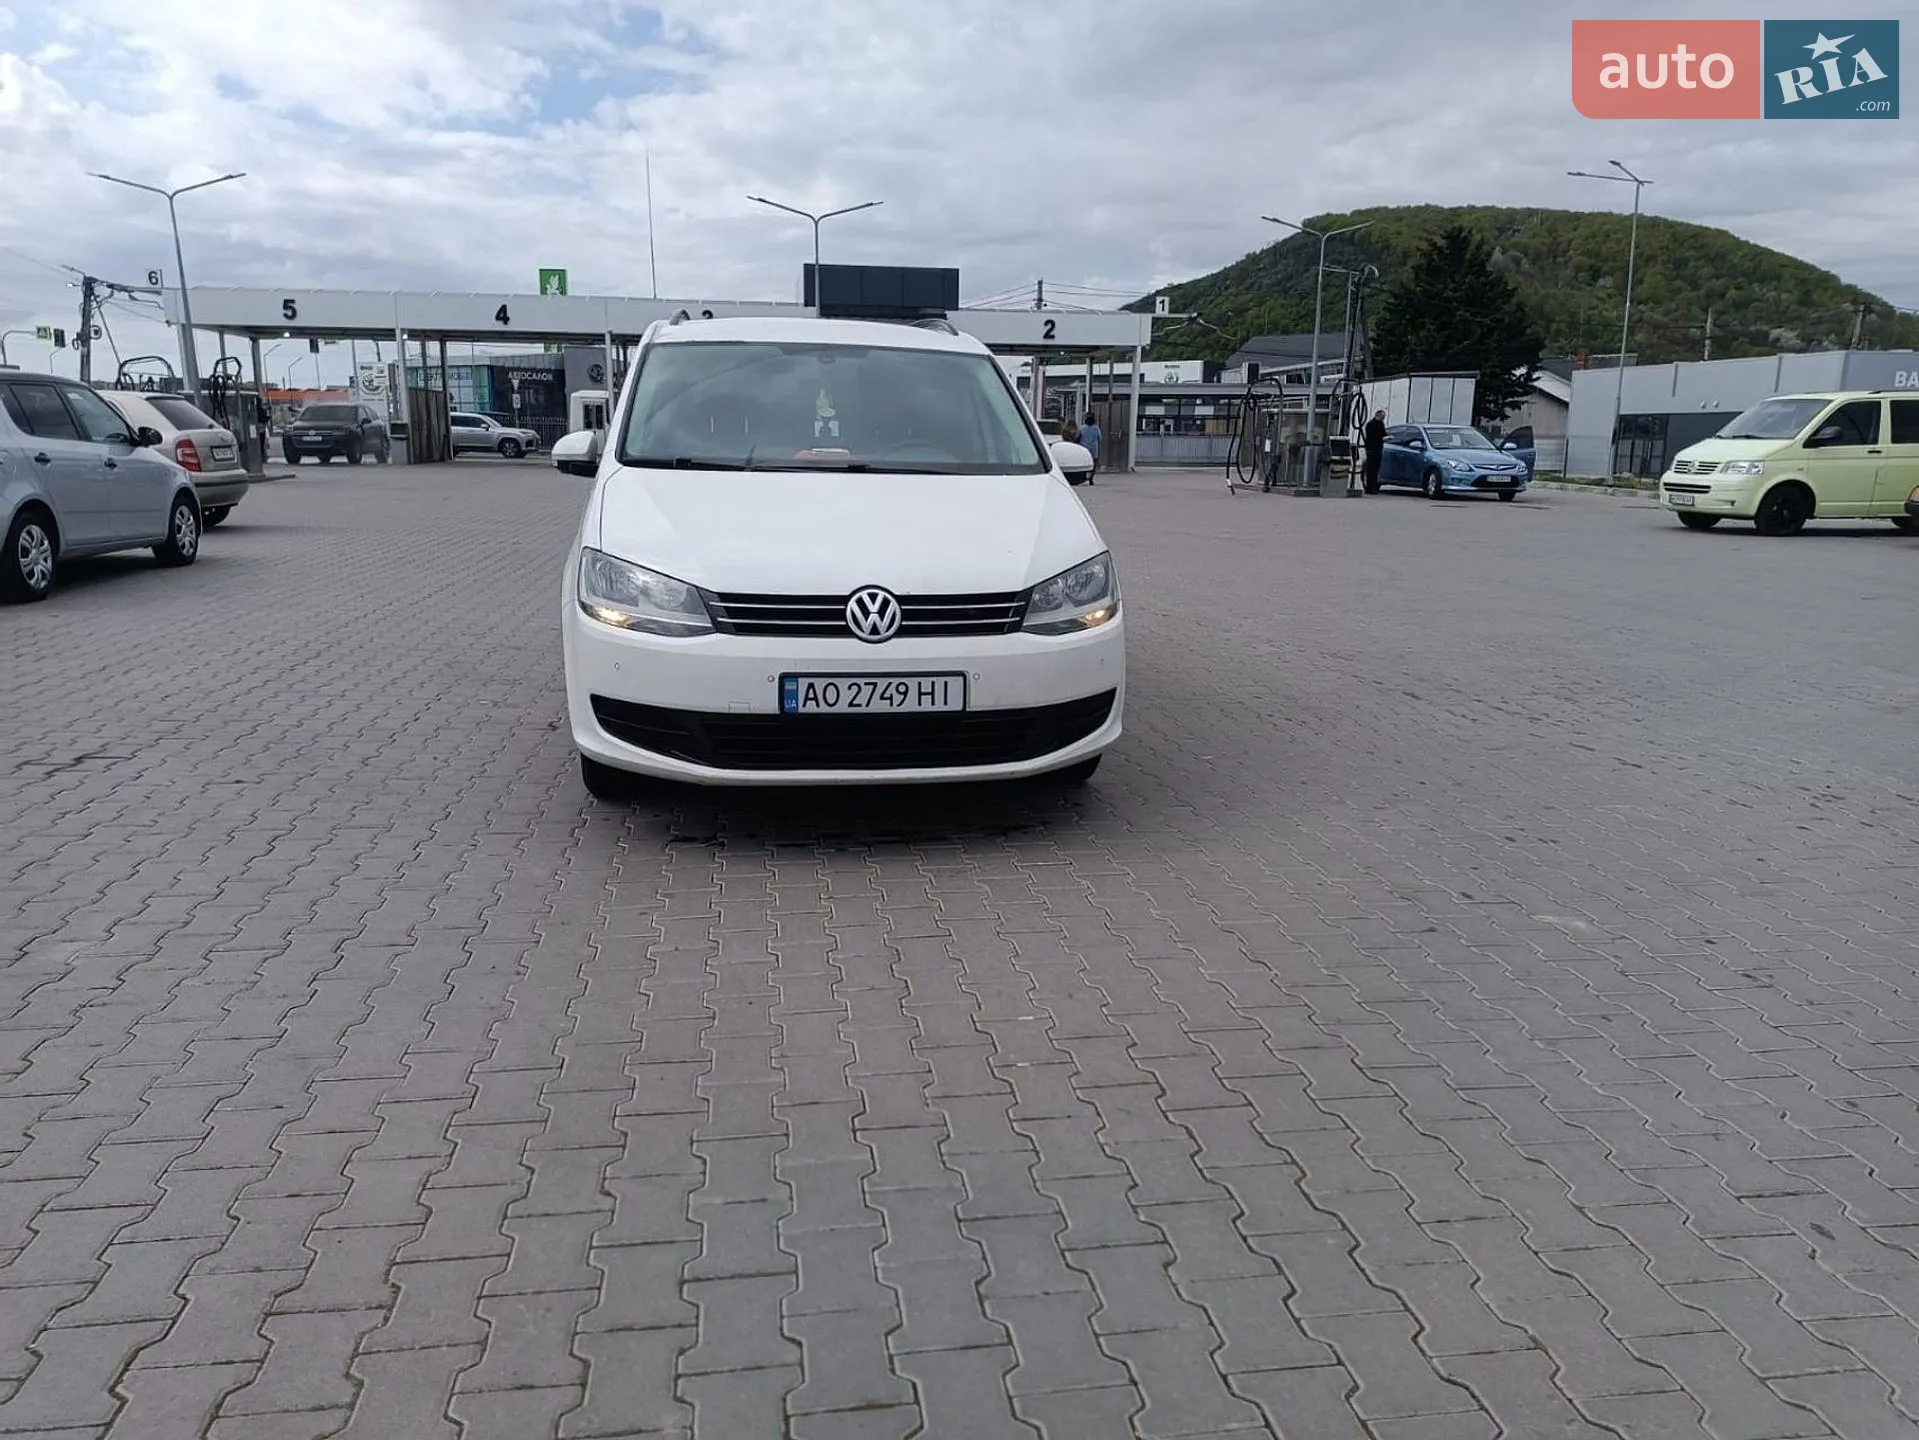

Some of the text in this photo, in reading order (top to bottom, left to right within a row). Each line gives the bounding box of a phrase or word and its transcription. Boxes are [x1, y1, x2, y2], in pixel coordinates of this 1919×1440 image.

[148, 271, 159, 285] 6
[282, 299, 297, 320] 5
[495, 304, 510, 325] 4
[1159, 299, 1166, 312] 1
[1043, 319, 1056, 340] 2
[784, 699, 798, 708] UA
[802, 681, 948, 708] AO 2749 HI
